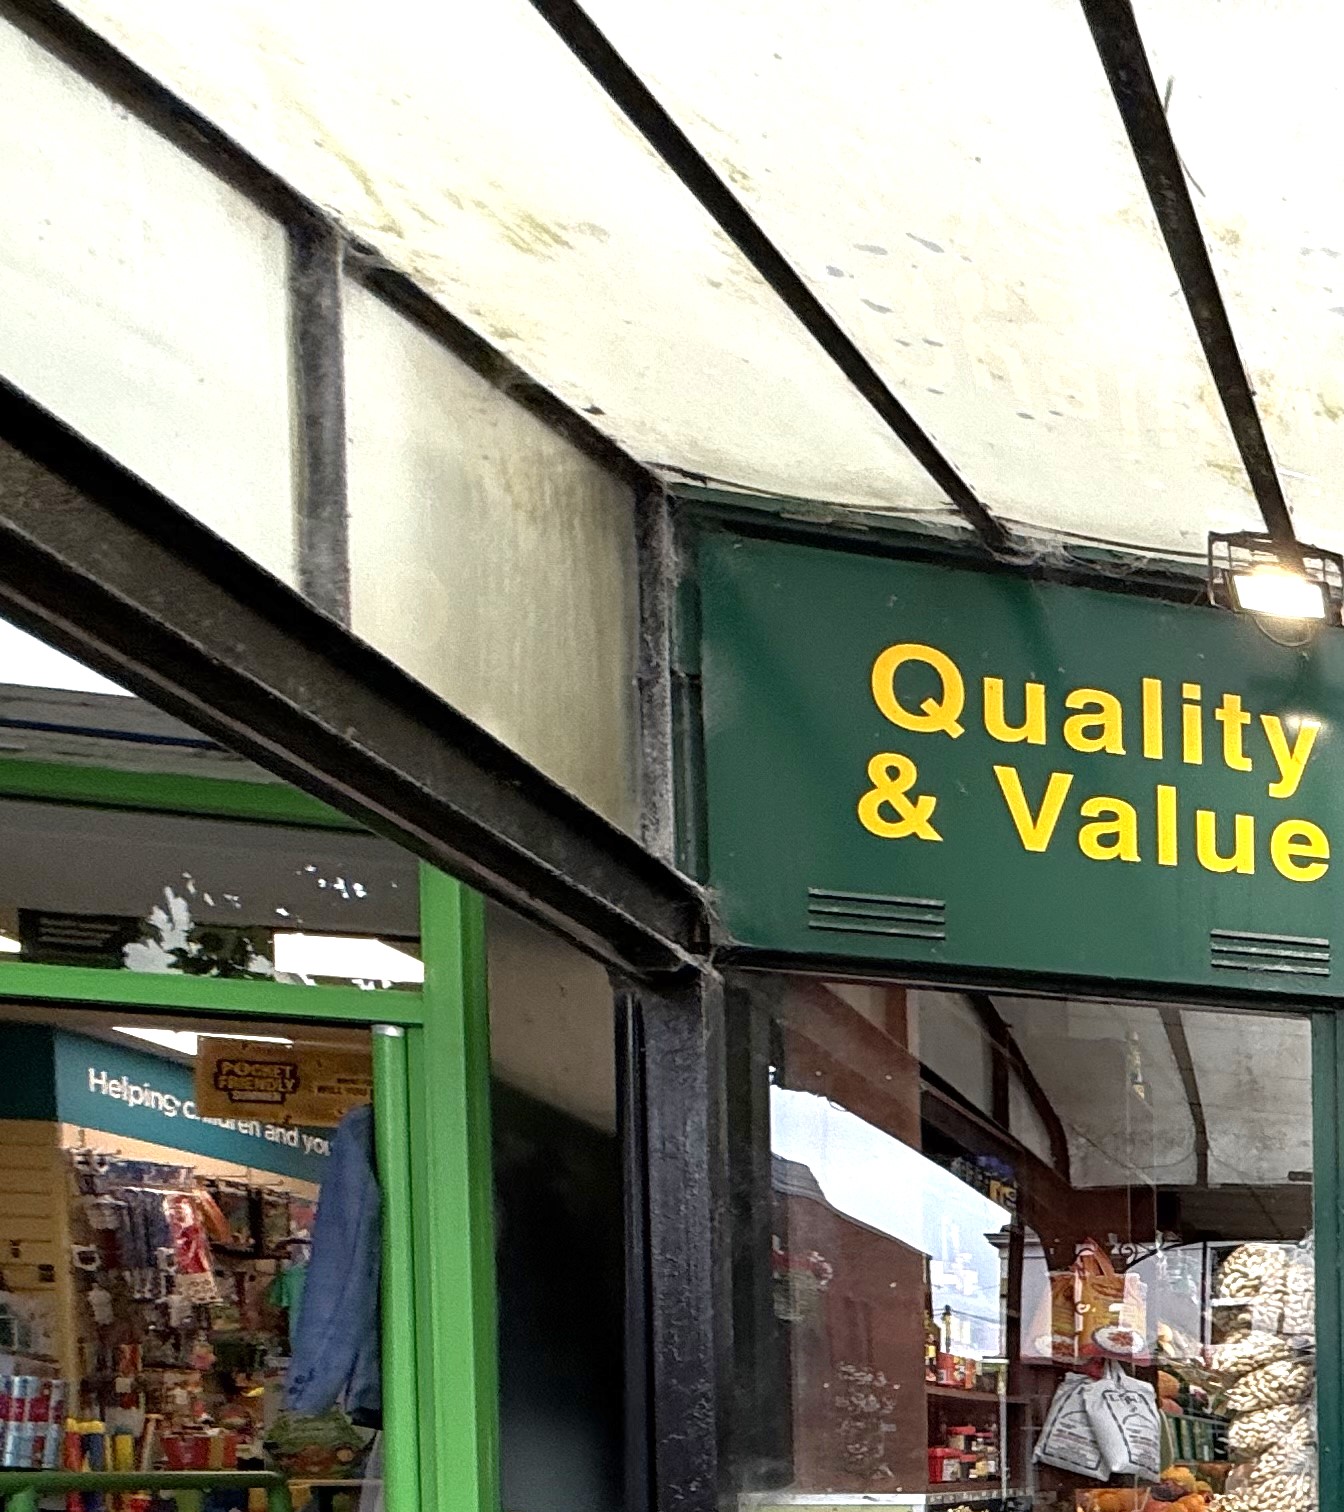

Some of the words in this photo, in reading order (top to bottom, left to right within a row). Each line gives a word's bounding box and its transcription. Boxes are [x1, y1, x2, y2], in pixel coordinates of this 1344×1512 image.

[872, 643, 1323, 799] Quality
[857, 752, 943, 842] &
[994, 765, 1331, 882] Value
[88, 1066, 179, 1117] Helping
[264, 1123, 299, 1149] and
